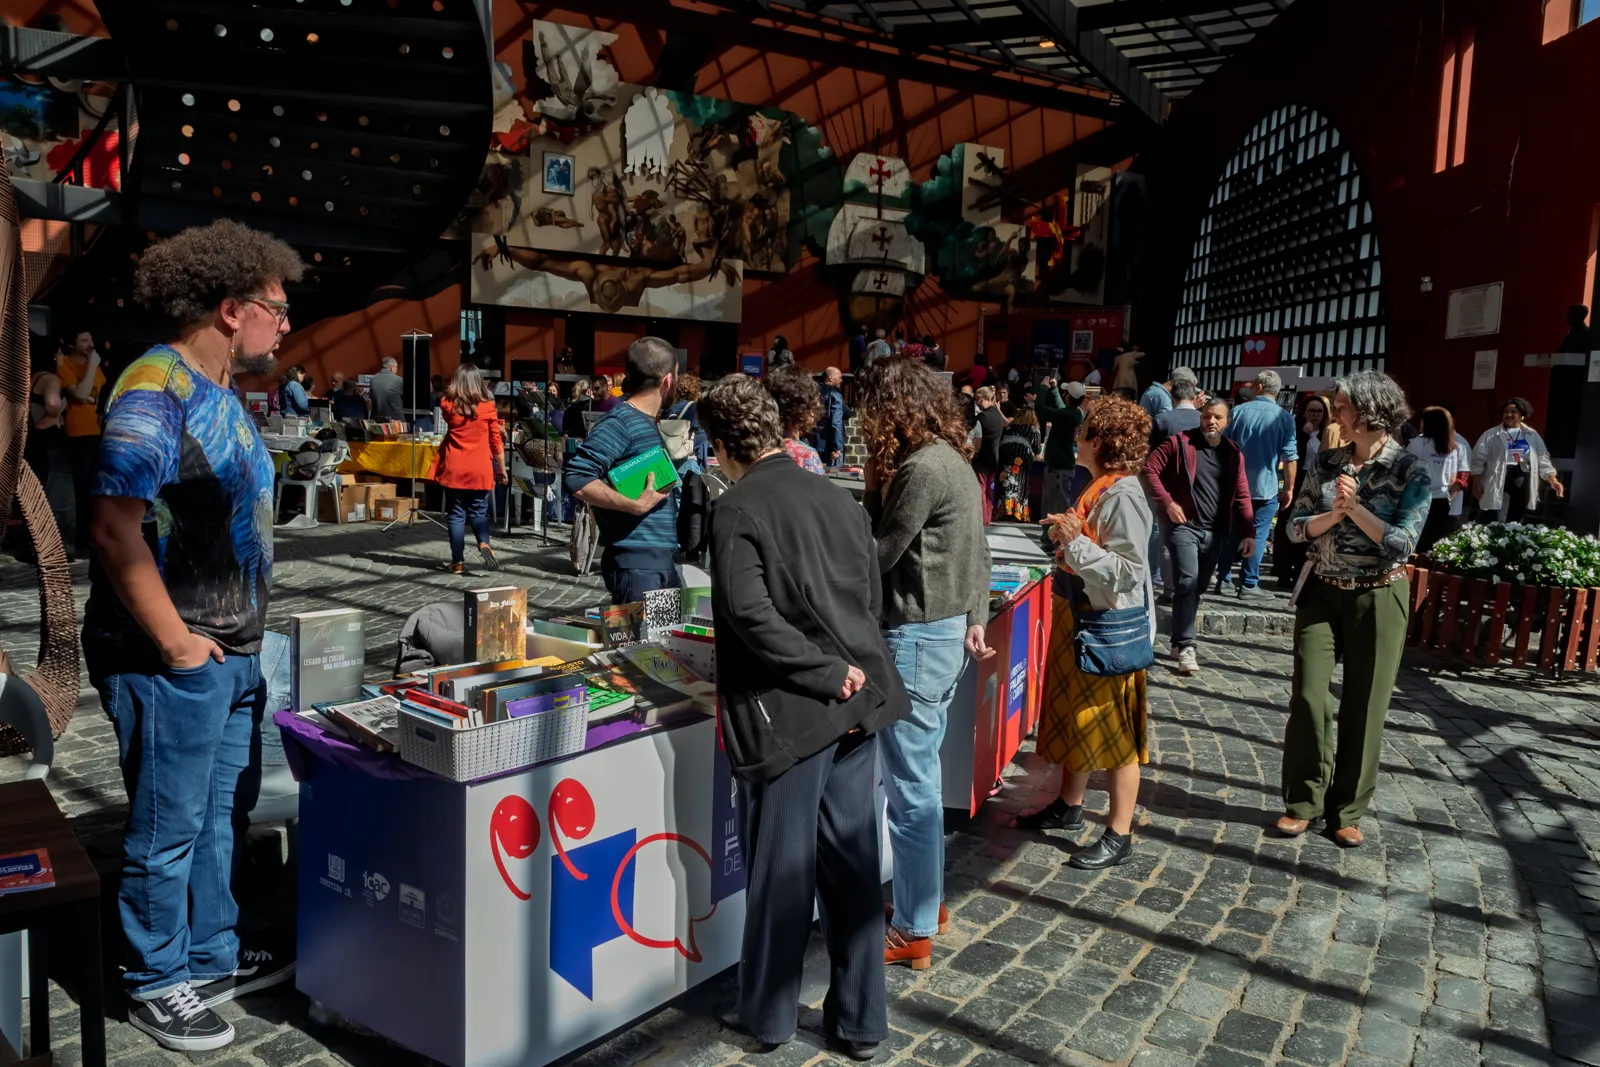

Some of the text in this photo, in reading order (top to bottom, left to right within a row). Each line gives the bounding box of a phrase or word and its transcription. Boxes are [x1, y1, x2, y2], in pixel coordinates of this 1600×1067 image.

[609, 631, 629, 642] VIDA
[303, 656, 322, 667] LEGADO
[724, 852, 741, 876] DE
